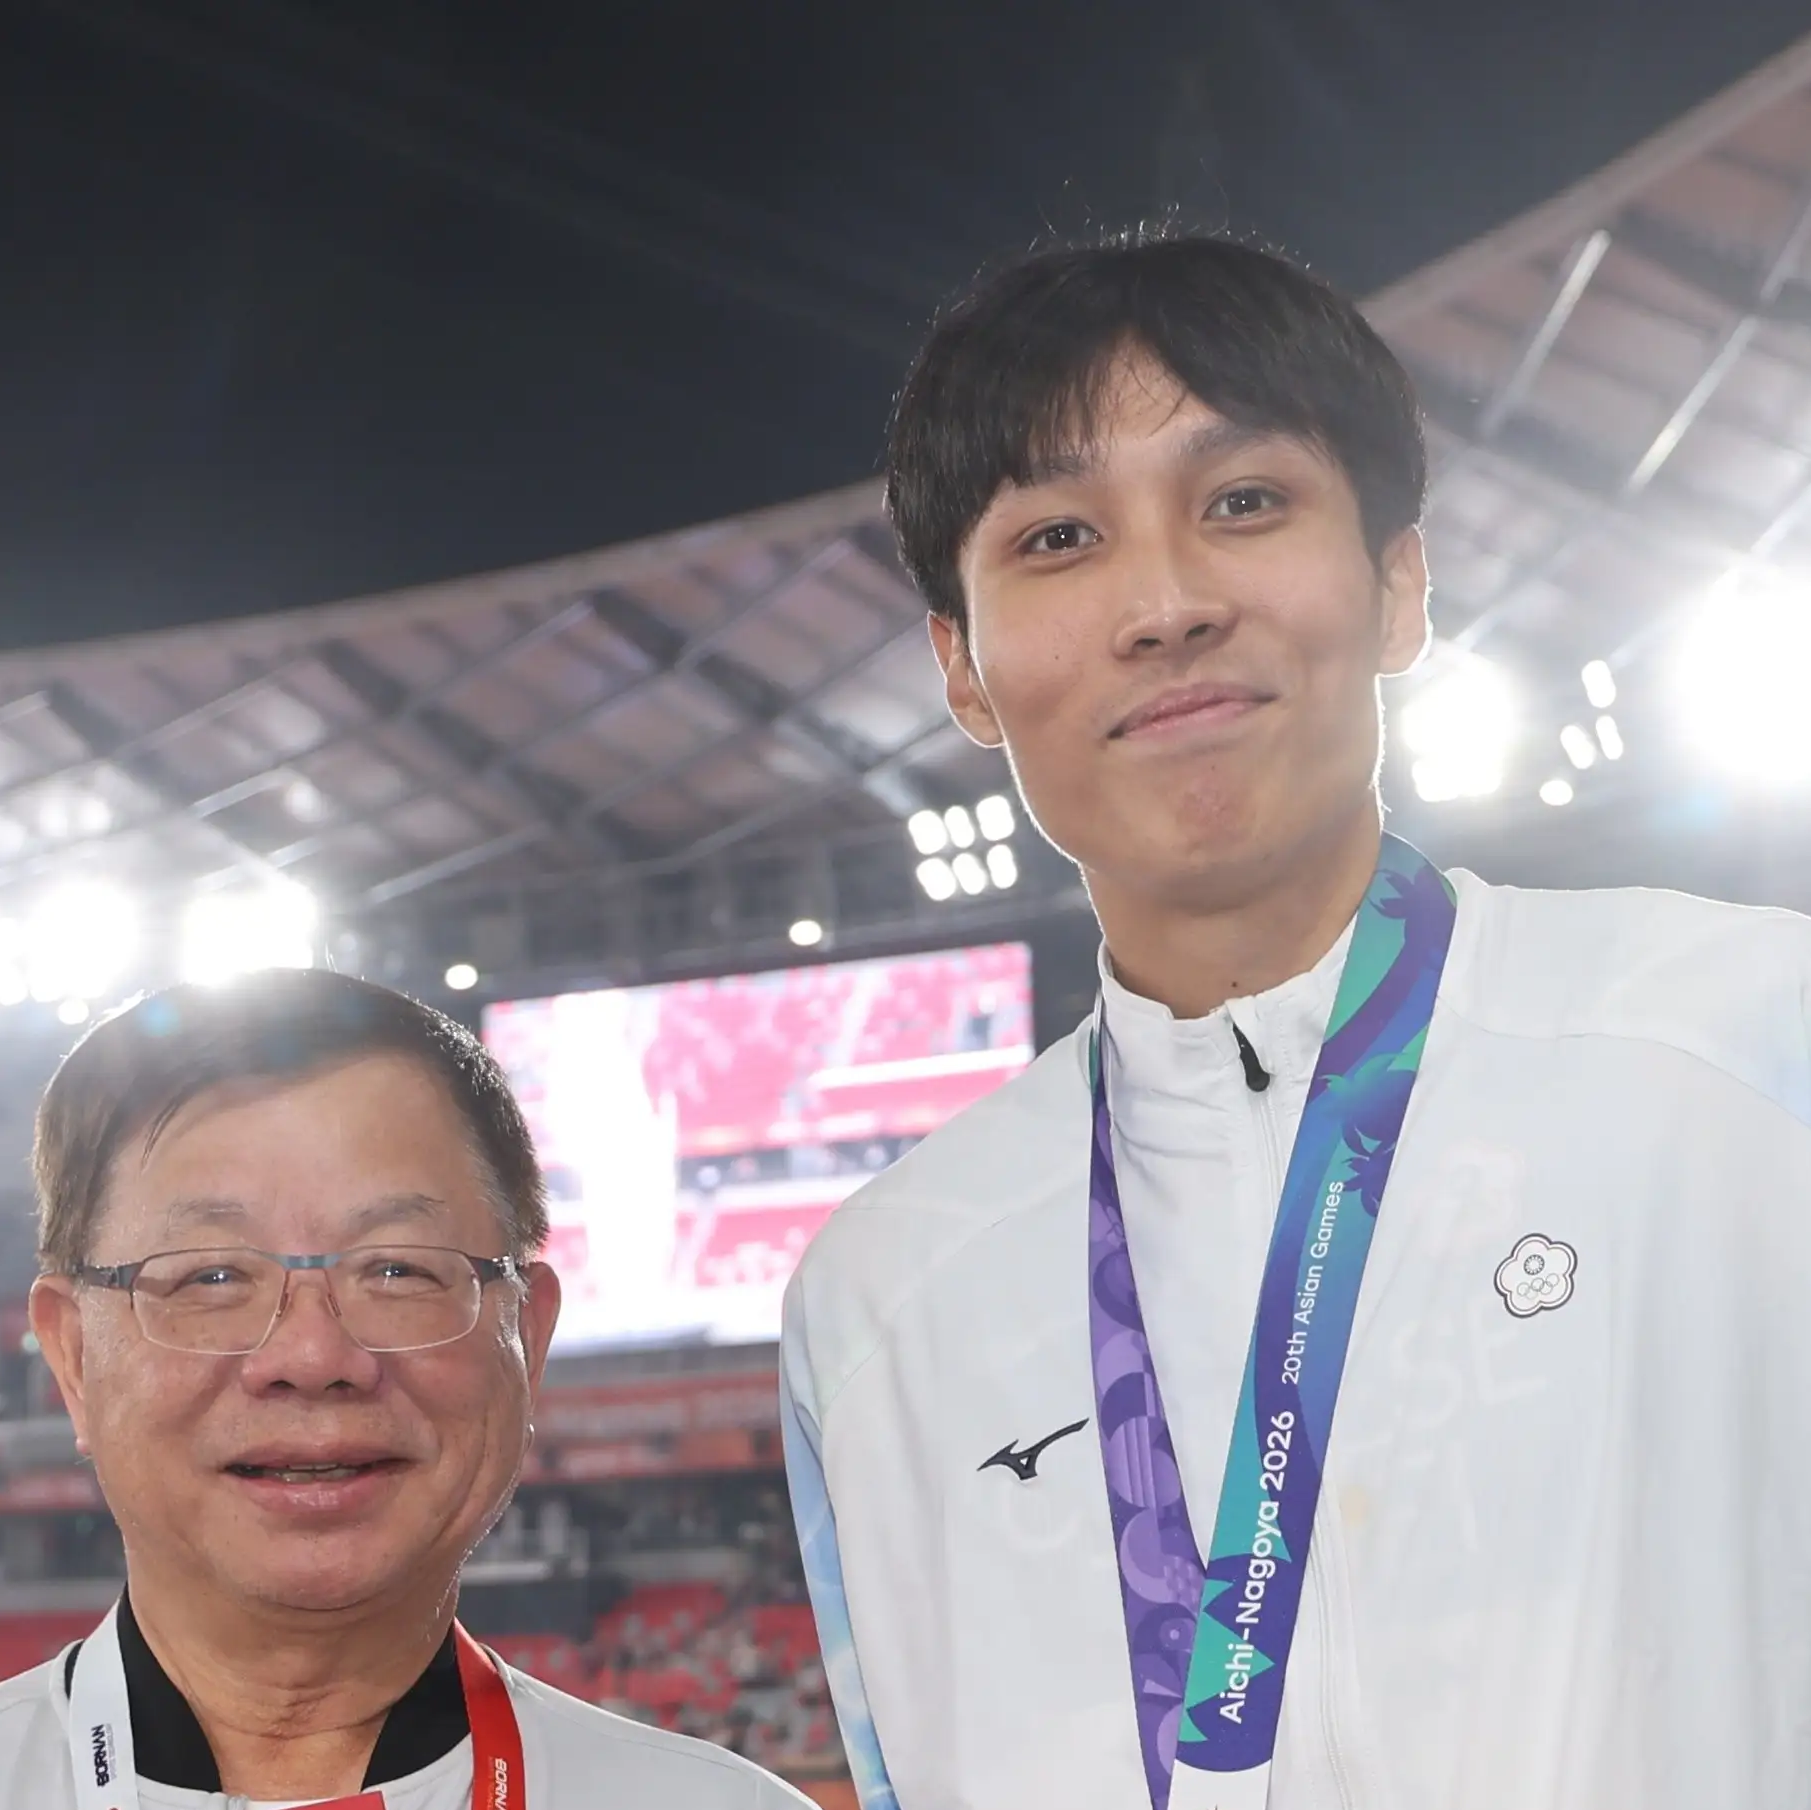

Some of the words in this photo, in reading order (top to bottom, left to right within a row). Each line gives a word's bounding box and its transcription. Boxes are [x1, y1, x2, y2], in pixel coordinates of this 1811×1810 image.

[1310, 1181, 1344, 1259] Games
[1294, 1265, 1324, 1325] Asian
[1282, 1331, 1307, 1385] 20th
[1219, 1499, 1280, 1724] Aichi-Nagoya
[1260, 1411, 1294, 1491] 2026
[91, 1724, 109, 1788] BORNAN
